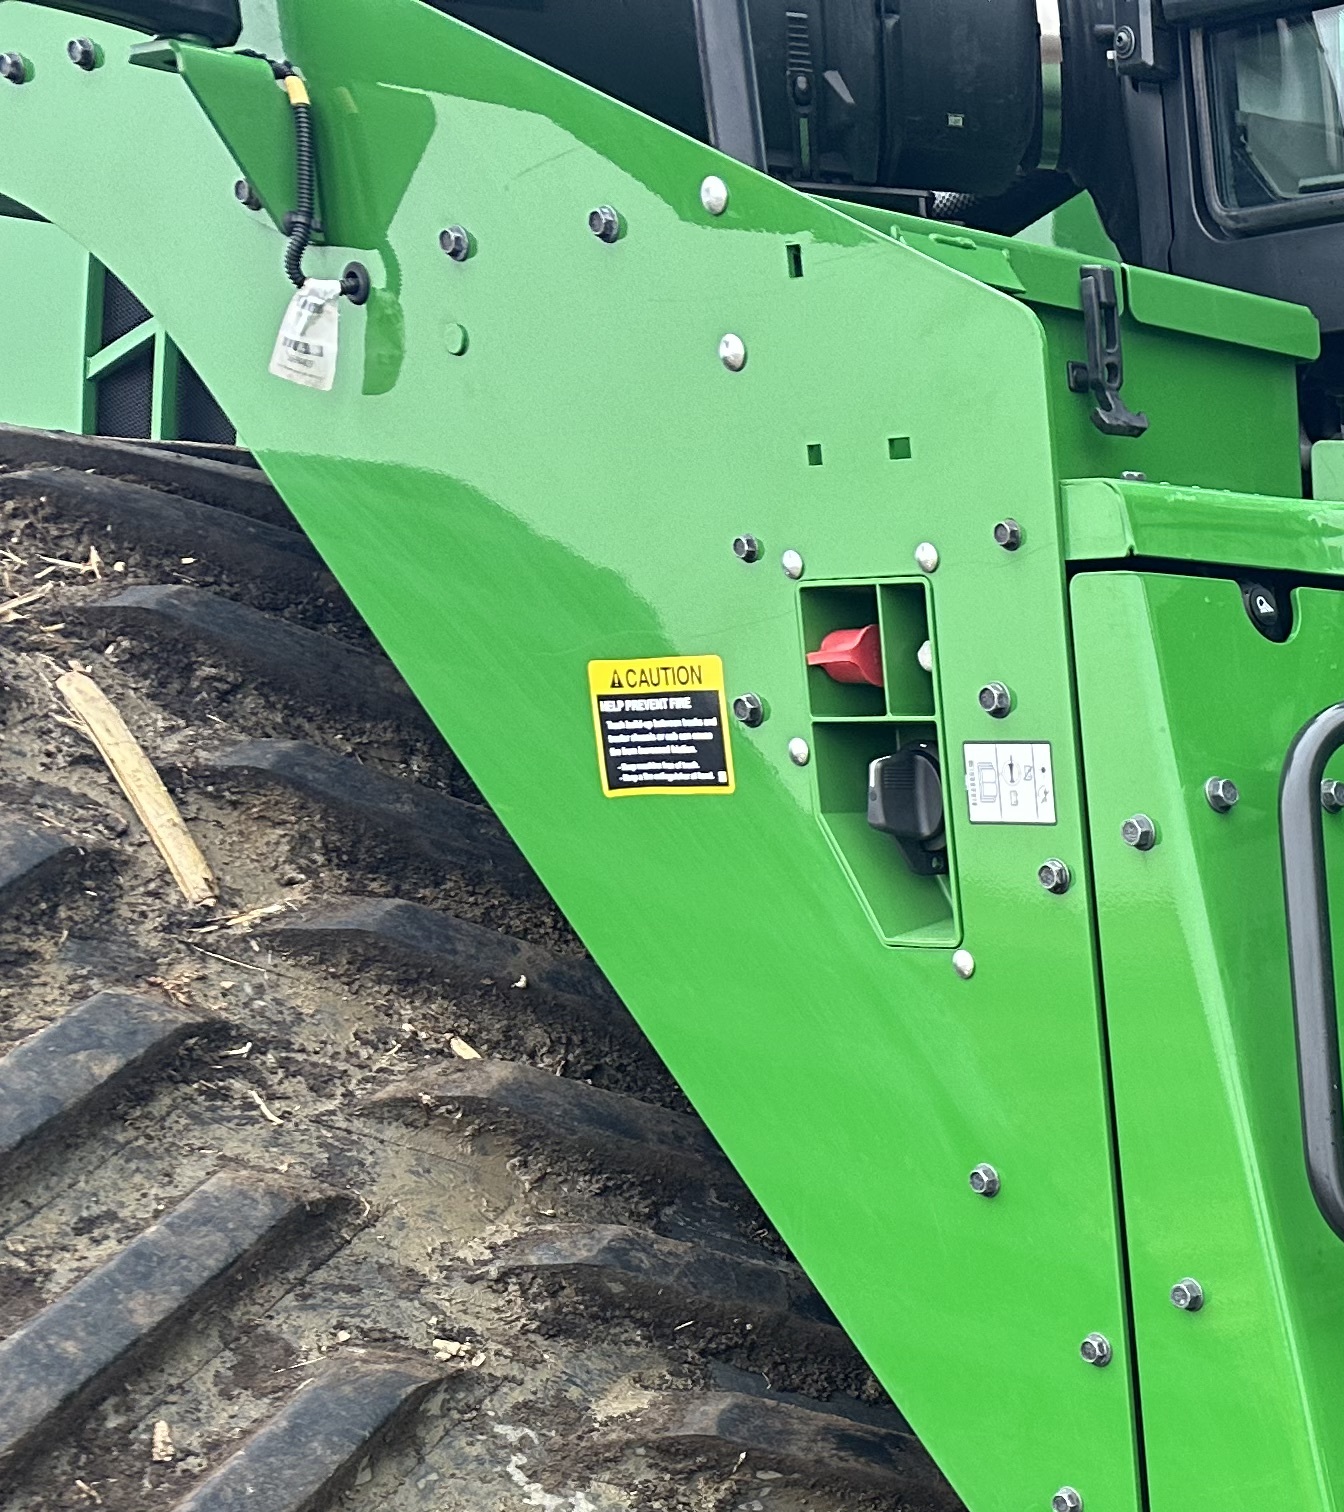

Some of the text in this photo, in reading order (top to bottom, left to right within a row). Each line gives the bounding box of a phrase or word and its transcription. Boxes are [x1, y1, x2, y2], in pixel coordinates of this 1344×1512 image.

[626, 665, 703, 688] CAUTION
[600, 697, 692, 712] HELP PREVENT FIRE
